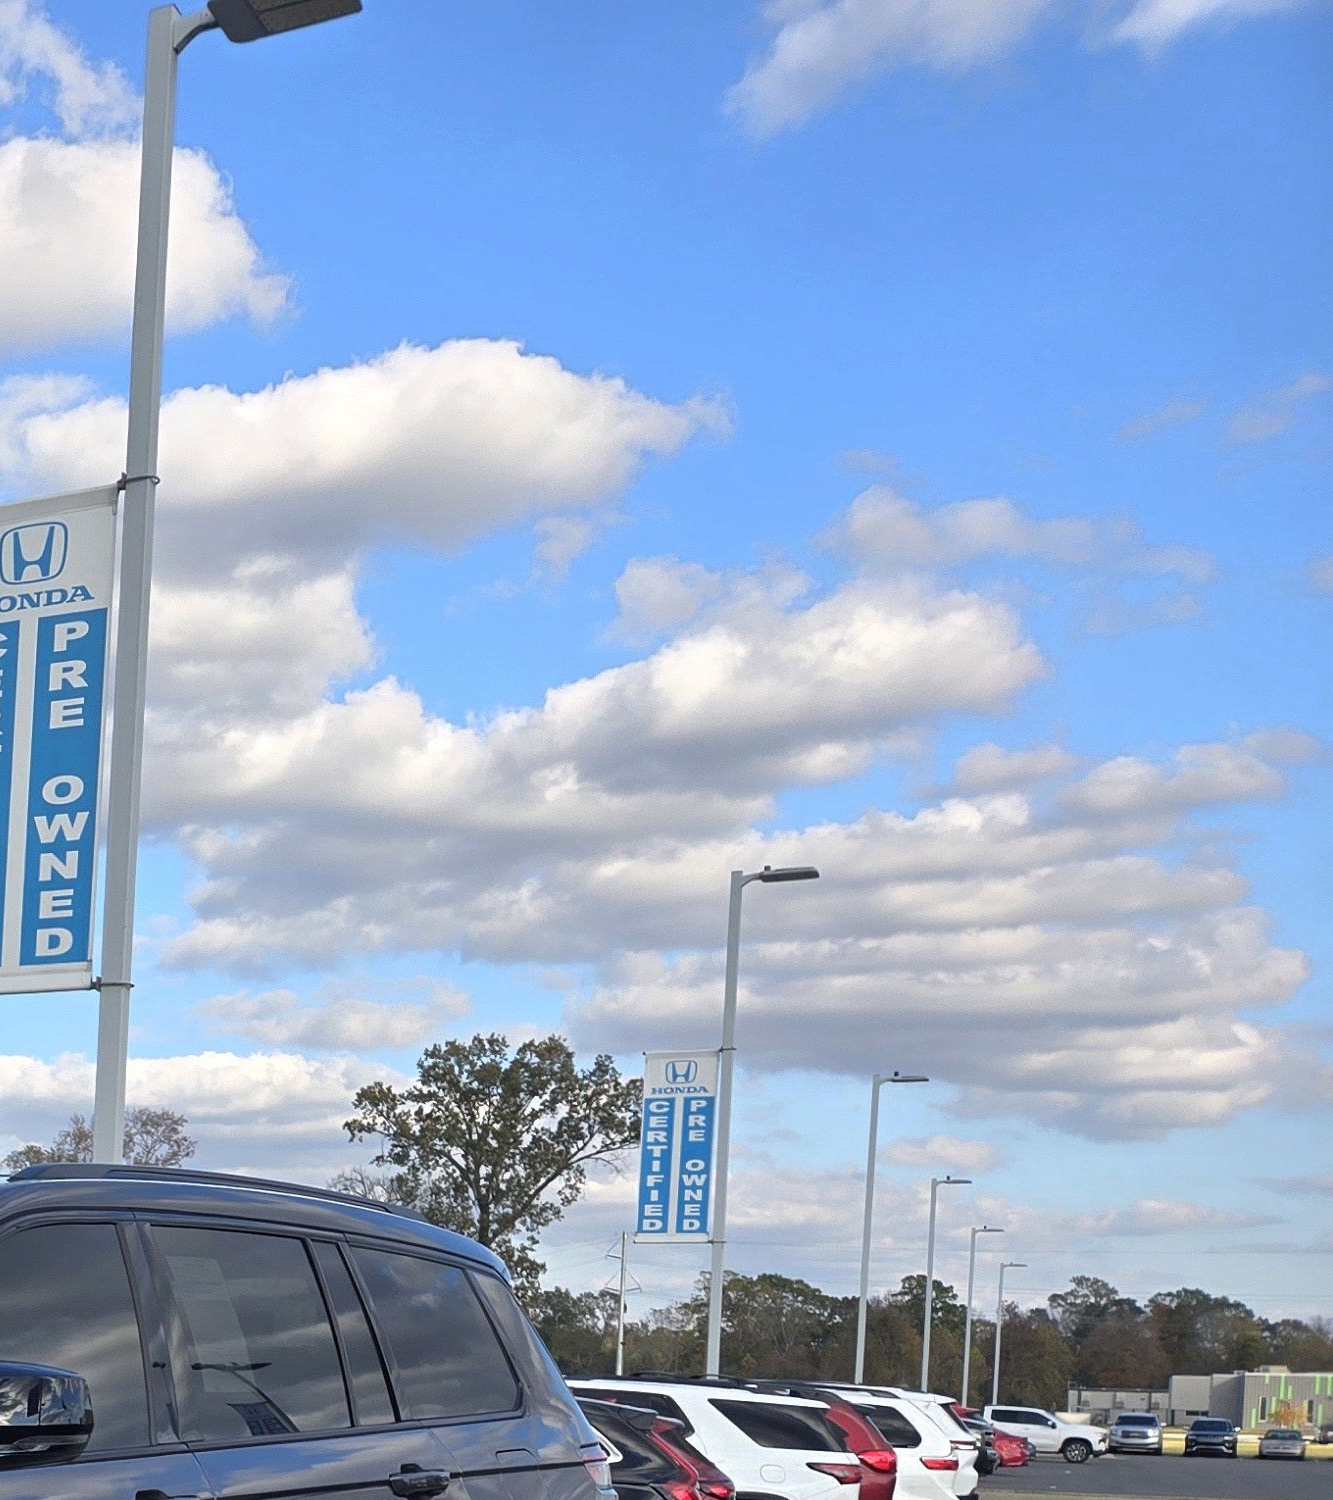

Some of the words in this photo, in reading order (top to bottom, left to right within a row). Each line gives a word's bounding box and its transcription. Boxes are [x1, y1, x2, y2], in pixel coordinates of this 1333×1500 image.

[48, 620, 90, 730] PRE
[33, 774, 90, 958] OWNED
[650, 1085, 709, 1095] HONDA
[687, 1099, 708, 1142] PRE
[642, 1100, 671, 1231] CERTIFIED
[681, 1158, 708, 1231] OWNED
